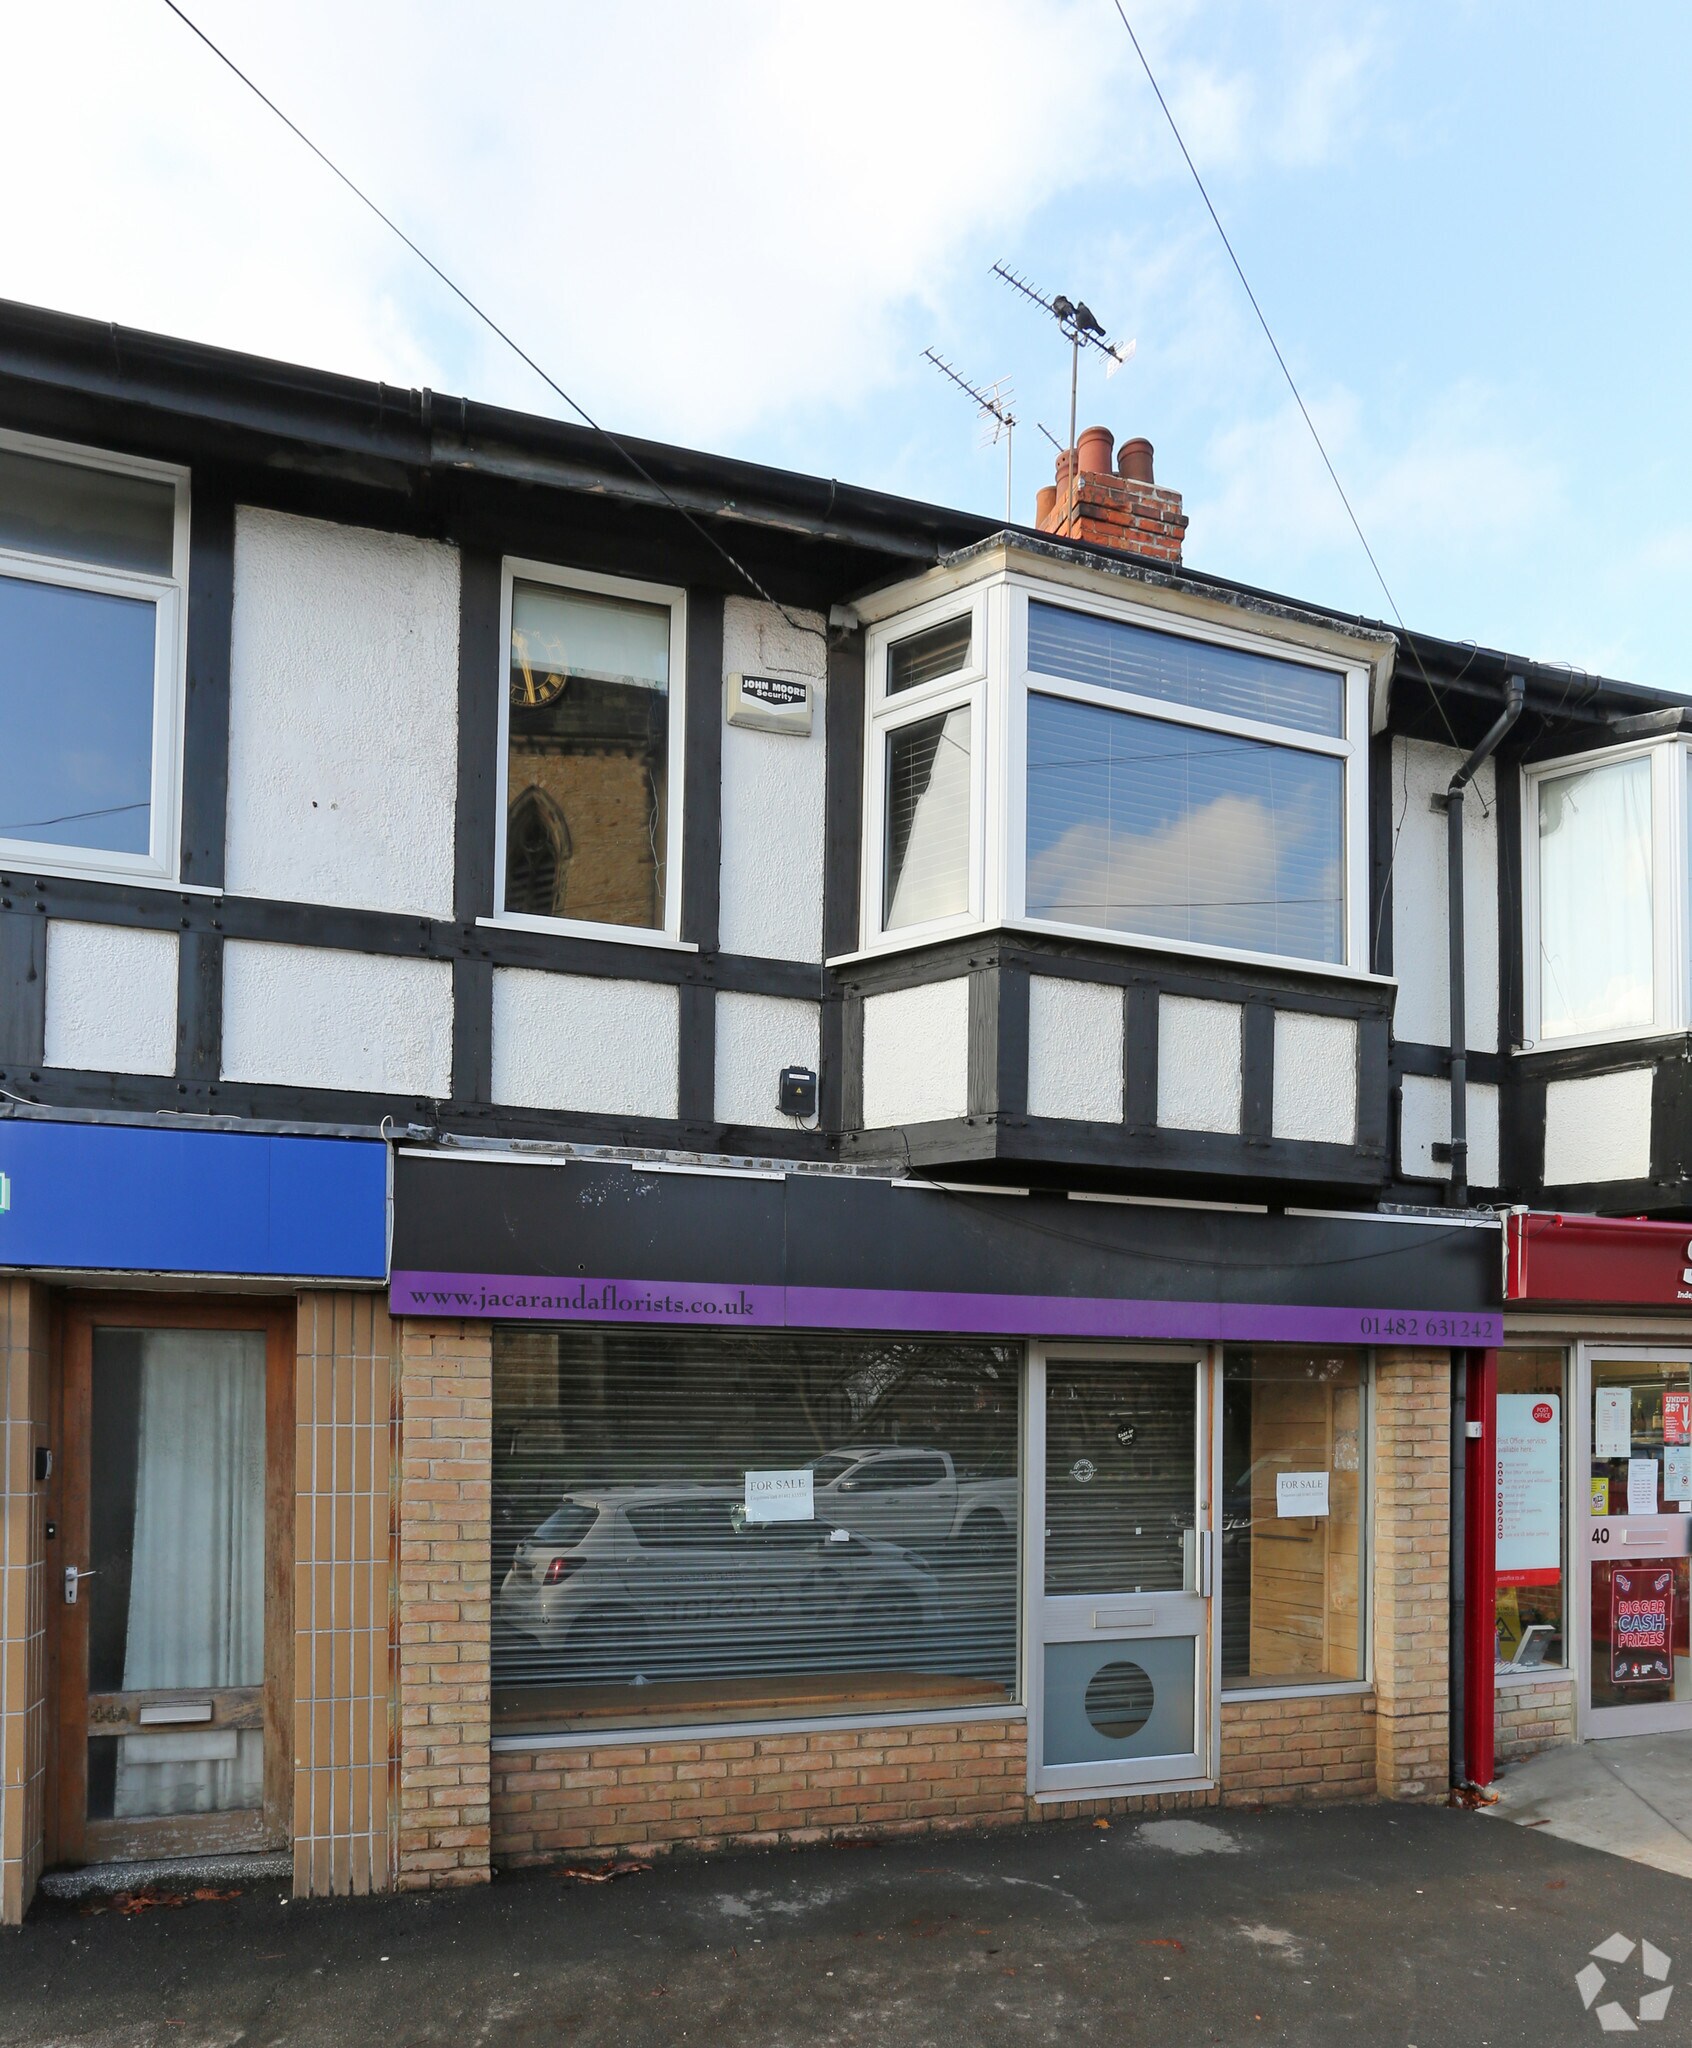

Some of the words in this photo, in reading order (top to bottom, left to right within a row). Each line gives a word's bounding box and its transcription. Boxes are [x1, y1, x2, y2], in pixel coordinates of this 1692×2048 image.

[743, 680, 768, 690] JOHN
[772, 683, 806, 698] MOORE
[756, 689, 793, 701] Security
[409, 1284, 754, 1315] www.jacarandaflorists.co.uk
[1361, 1316, 1418, 1336] 01482
[1425, 1318, 1493, 1338] 631242
[1665, 1403, 1680, 1413] 25?
[1497, 1437, 1509, 1445] Post
[750, 1481, 773, 1491] FOR
[775, 1478, 806, 1490] SALE
[1281, 1480, 1299, 1490] FOR
[1300, 1479, 1323, 1489] SALE
[1591, 1527, 1610, 1544] 40
[1618, 1600, 1666, 1615] BIGGER
[1618, 1614, 1666, 1632] CASH
[1618, 1631, 1665, 1648] PRIZES
[91, 1704, 130, 1722] 44A
